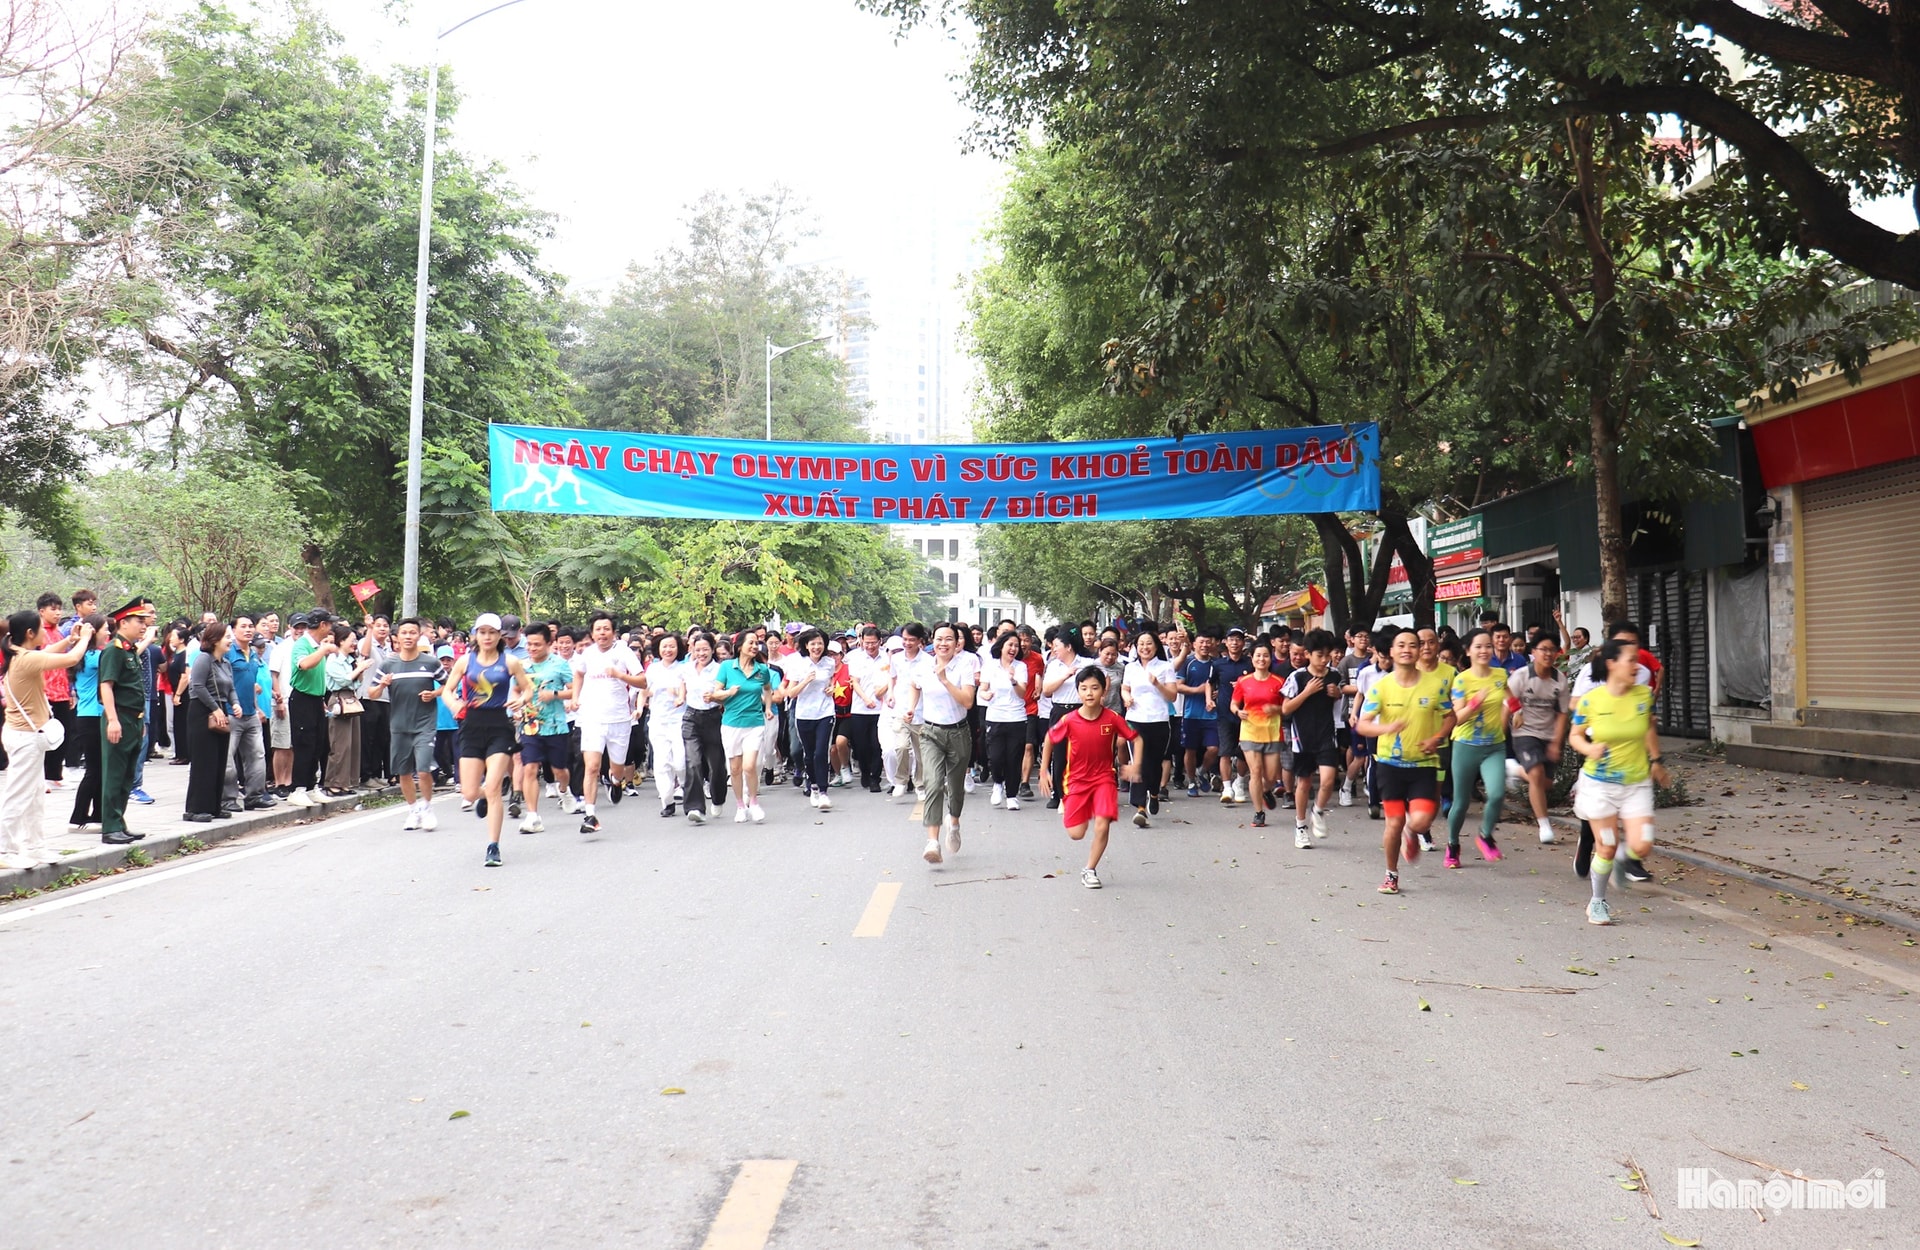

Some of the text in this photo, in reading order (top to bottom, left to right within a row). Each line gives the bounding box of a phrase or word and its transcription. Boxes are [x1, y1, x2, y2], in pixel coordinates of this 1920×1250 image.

[513, 436, 1356, 482] NGÀY CHẠY OLYMPIC VÌ SỨC KHOẺ TOÀN DÂN
[763, 488, 1098, 520] XUẤT PHÁT / ĐÍCH
